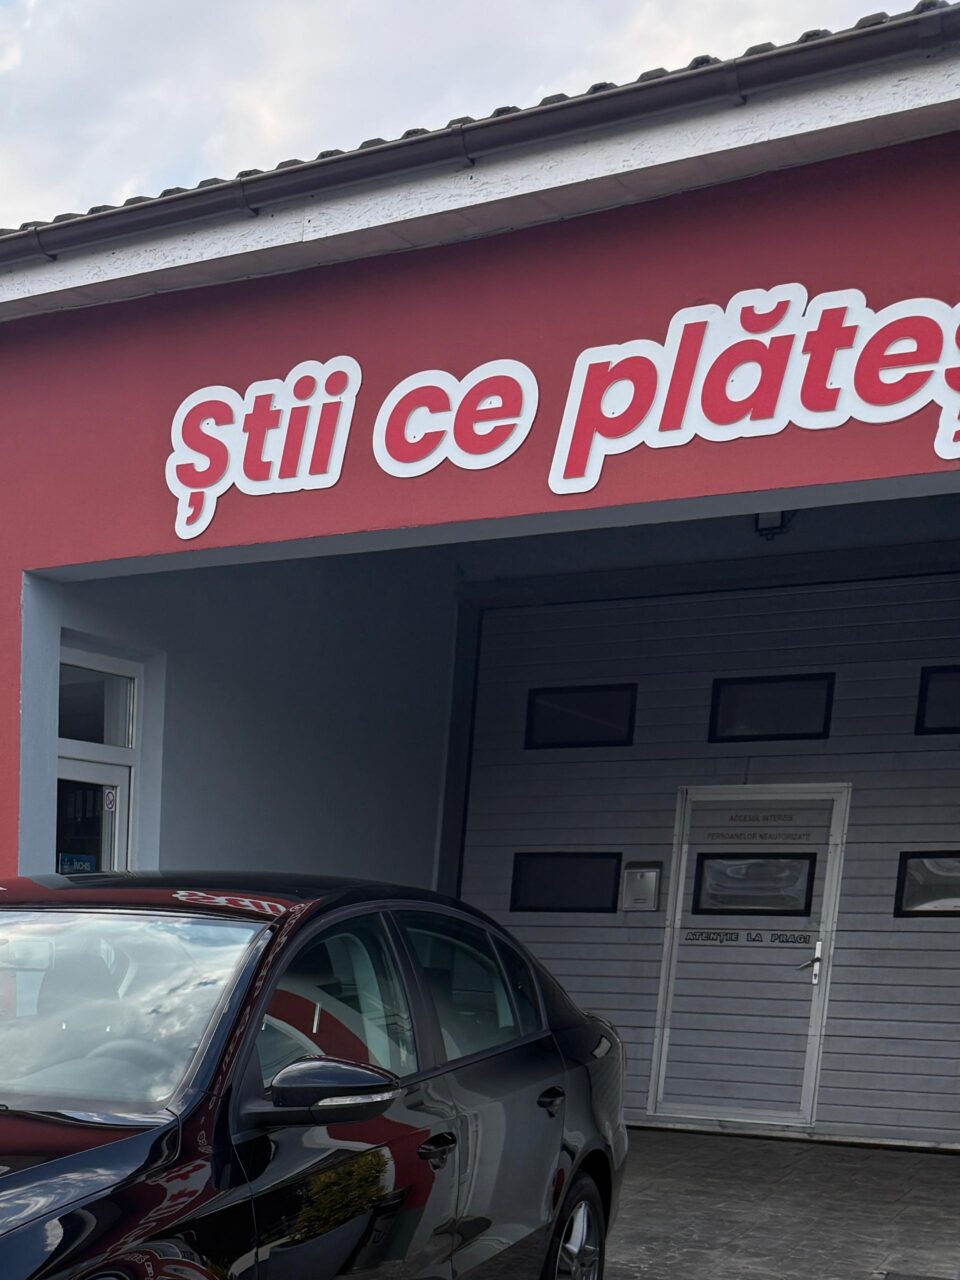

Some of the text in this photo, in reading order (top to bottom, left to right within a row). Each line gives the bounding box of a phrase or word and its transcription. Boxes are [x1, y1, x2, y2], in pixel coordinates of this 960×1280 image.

[381, 371, 527, 466] ce
[560, 296, 960, 482] plăte
[746, 932, 763, 942] LA
[770, 933, 811, 944] PRAG!
